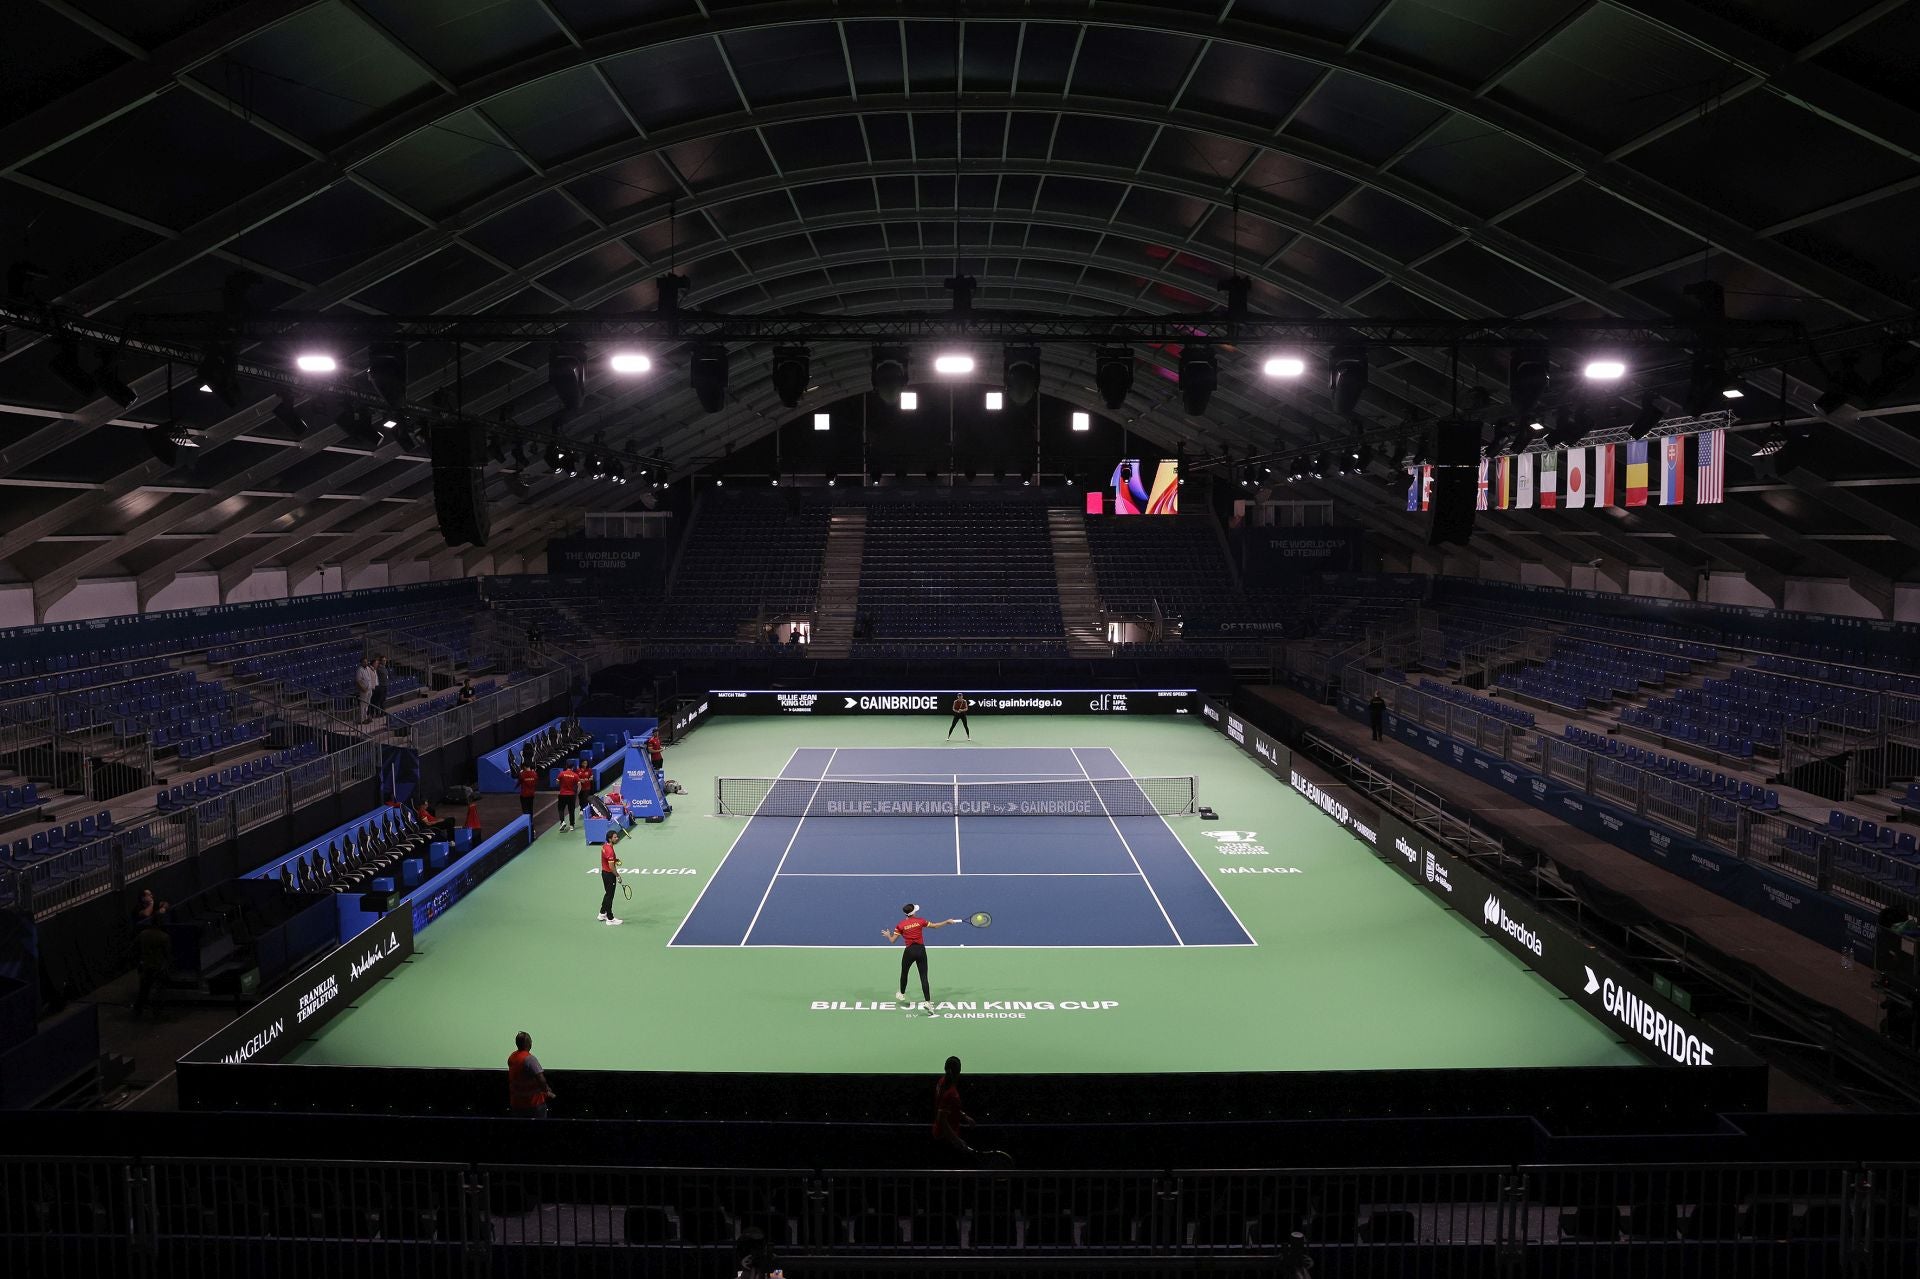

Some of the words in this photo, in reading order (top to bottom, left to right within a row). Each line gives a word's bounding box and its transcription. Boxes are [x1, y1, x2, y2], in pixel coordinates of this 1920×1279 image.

[564, 552, 584, 560] THE
[584, 552, 620, 560] WORLD
[620, 552, 640, 560] CUP
[579, 560, 592, 568] OF
[592, 560, 626, 568] TENNIS
[860, 696, 938, 710] GAINBRIDGE
[978, 698, 997, 708] visit
[999, 698, 1062, 709] gainbridge.io
[1291, 770, 1306, 794] BILLIE
[1306, 782, 1320, 806] JEAN
[1320, 791, 1335, 816] KING
[1335, 802, 1348, 825] CUP
[828, 800, 872, 813] BILLIE
[874, 800, 912, 813] JEAN
[914, 800, 952, 813] KING
[959, 800, 990, 813] CUP
[1021, 800, 1091, 813] GAINBRIDGE
[1501, 908, 1542, 957] Iberdrola
[300, 975, 335, 1009] FRANKLIN
[297, 984, 338, 1023] TEMPLETON
[810, 1001, 896, 1010] BILLIE
[900, 1001, 977, 1010] JEAN
[983, 1001, 1056, 1010] KING
[1060, 1001, 1119, 1010] CUP
[1603, 977, 1714, 1065] GAINBRIDGE
